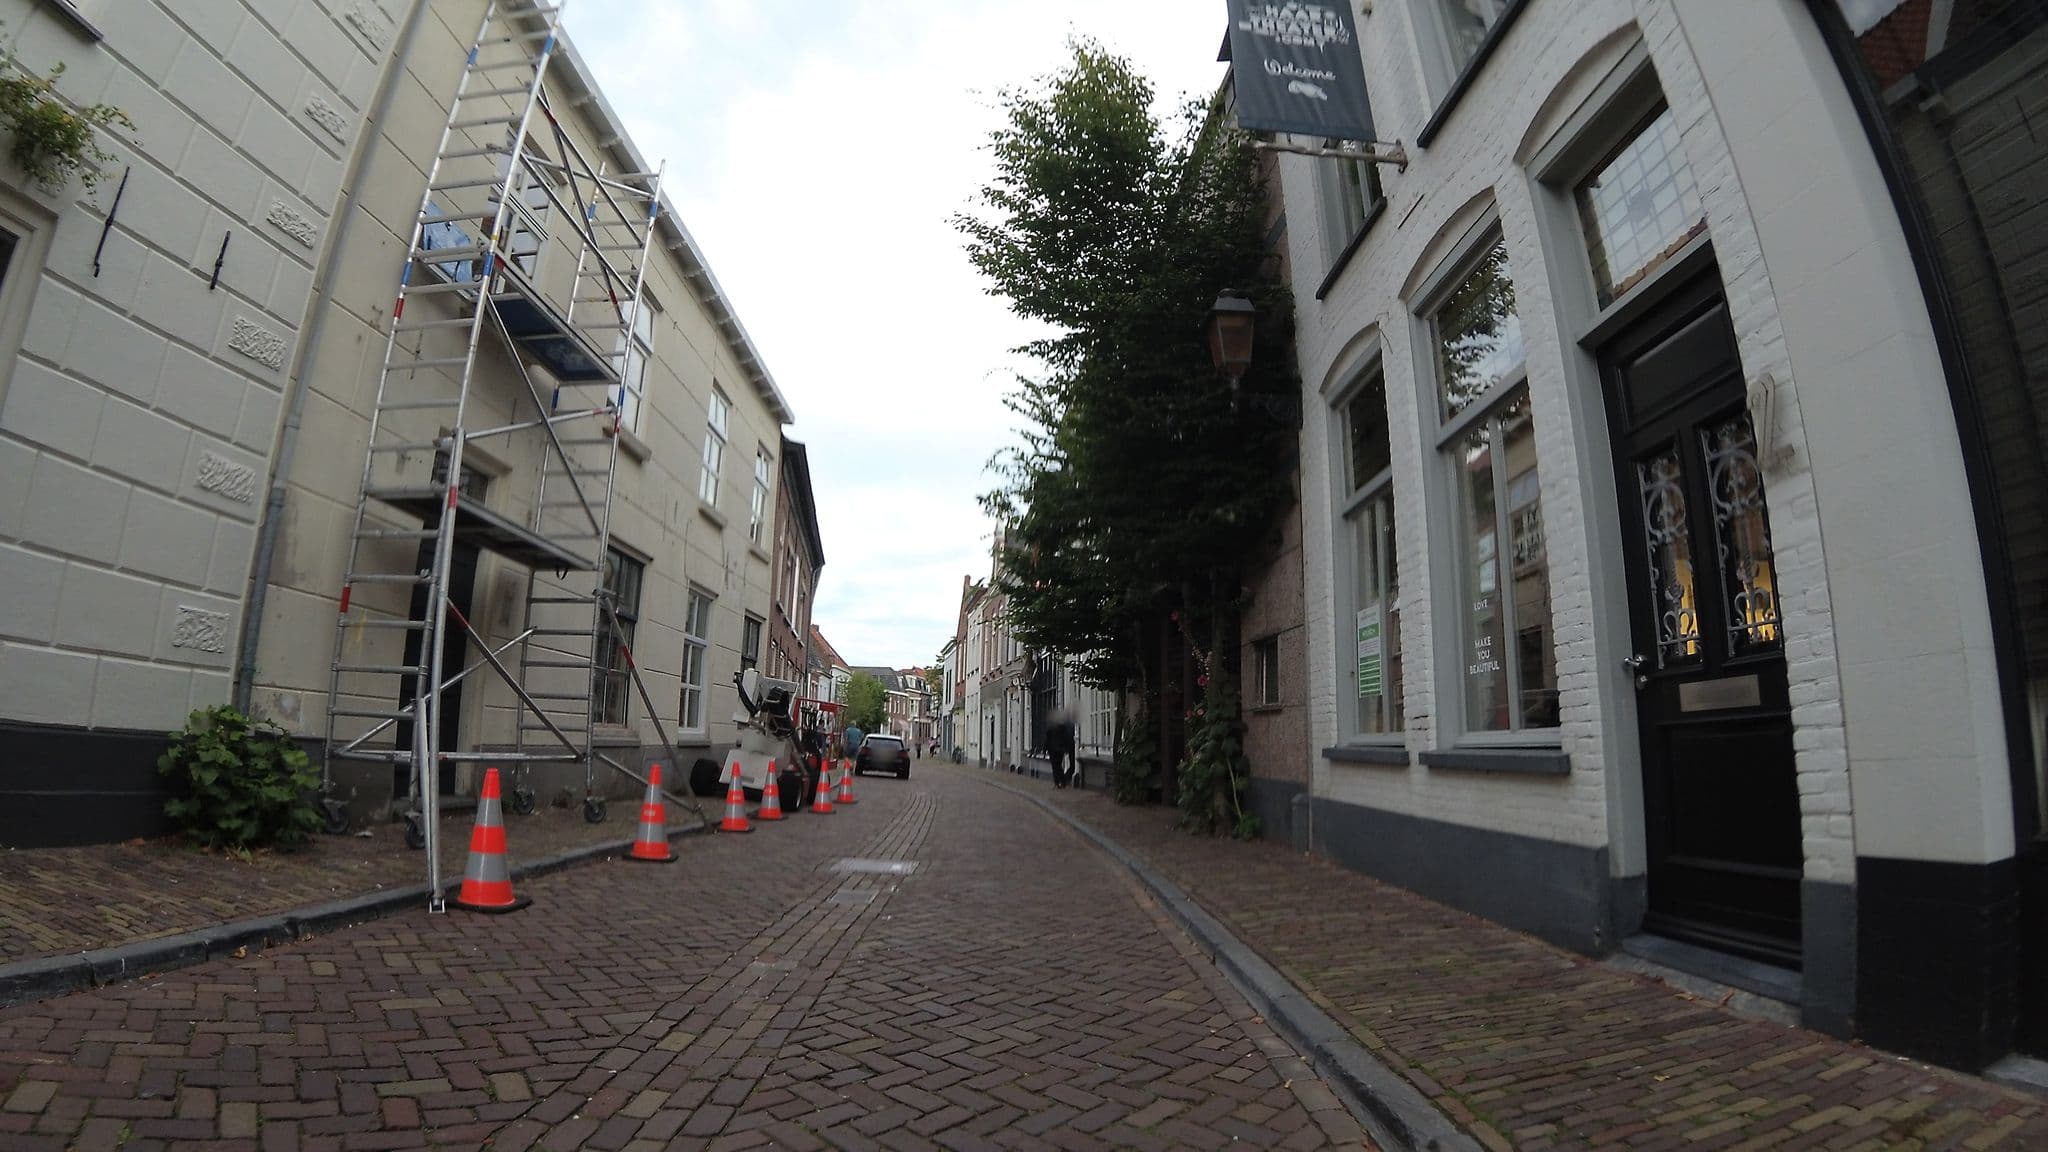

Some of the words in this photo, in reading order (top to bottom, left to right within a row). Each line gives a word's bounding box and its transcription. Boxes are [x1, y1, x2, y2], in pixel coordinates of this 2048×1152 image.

[1264, 57, 1336, 80] Welcome
[1473, 599, 1488, 611] LOVE
[1474, 636, 1491, 648] MAKE
[1477, 649, 1490, 660] YOU
[1469, 660, 1500, 675] BEAUTIFUL
